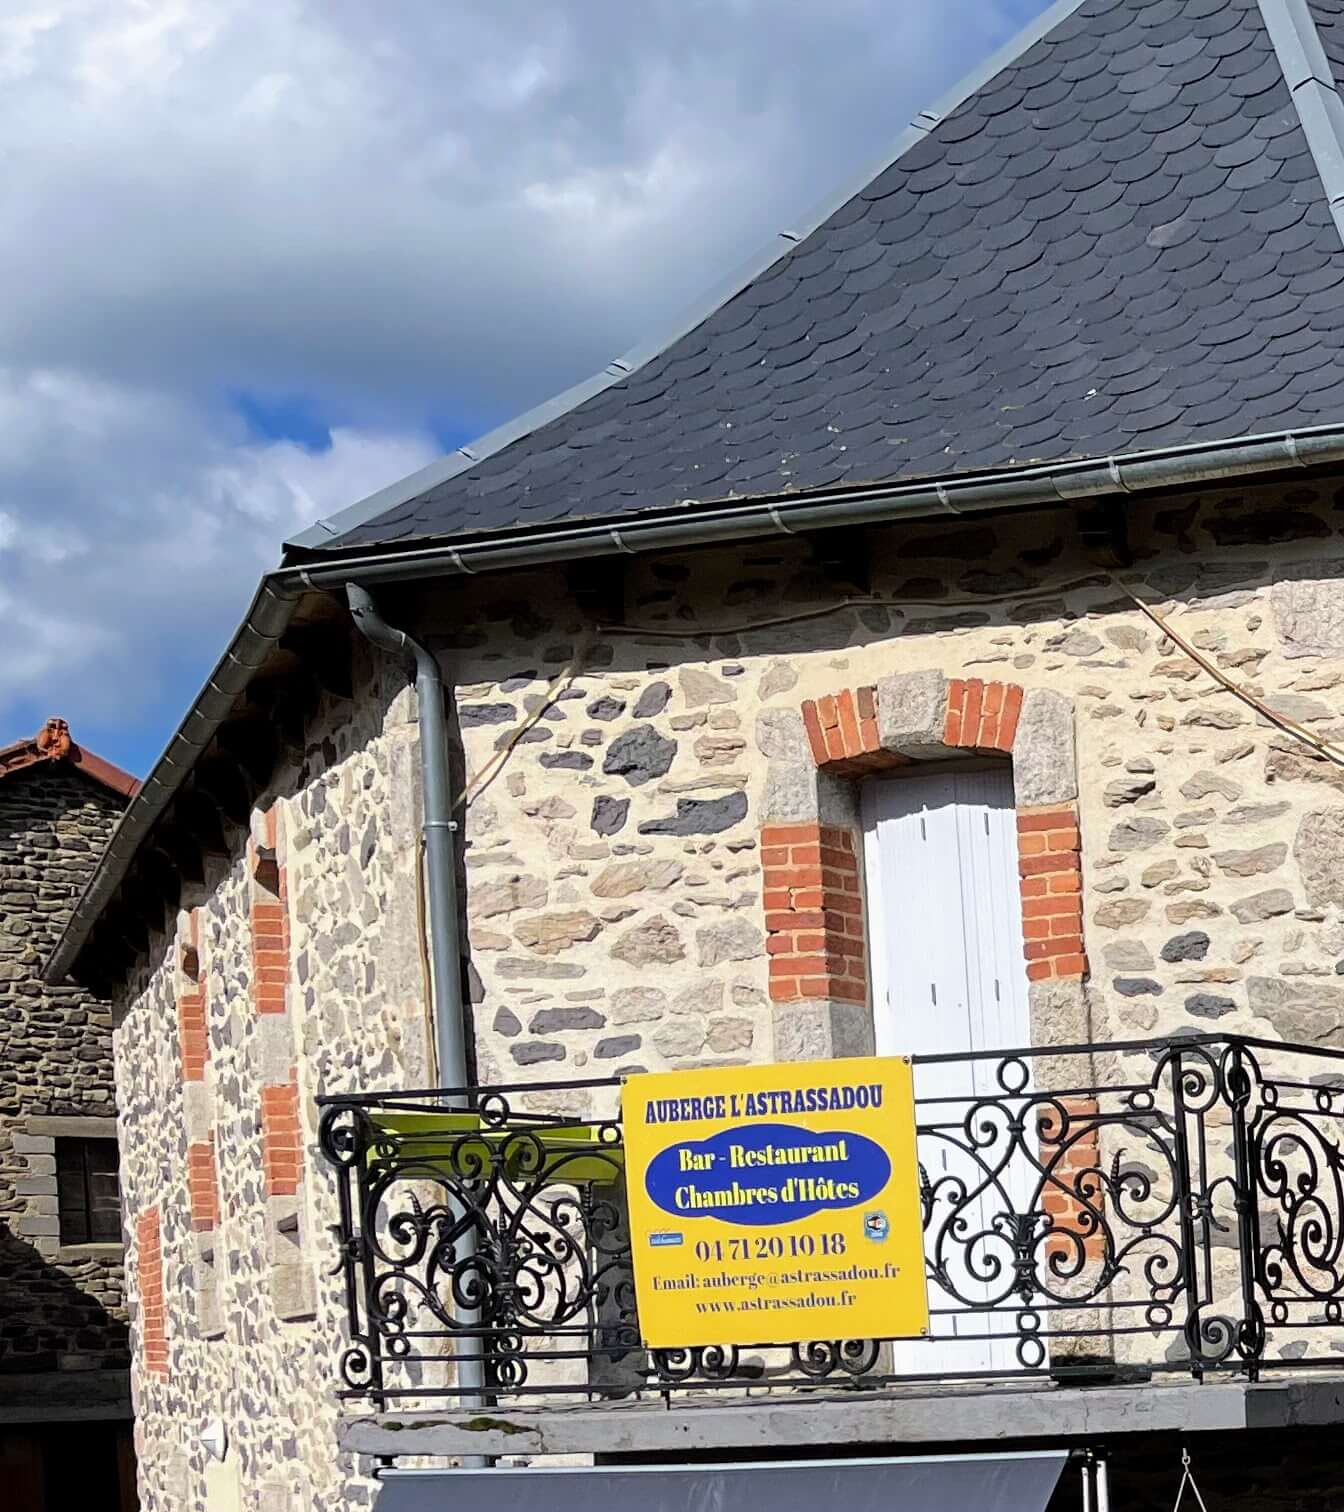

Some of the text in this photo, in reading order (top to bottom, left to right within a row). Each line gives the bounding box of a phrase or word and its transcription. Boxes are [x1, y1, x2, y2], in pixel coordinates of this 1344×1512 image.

[645, 1084, 883, 1124] AUBERGE L'ASTRASSADOU
[679, 1148, 716, 1172] Bar
[729, 1139, 849, 1168] Restaurant
[675, 1177, 860, 1209] Chambres d'Hôtes
[729, 1238, 751, 1260] 71
[755, 1236, 783, 1258] 20
[821, 1232, 846, 1255] 18
[652, 1273, 700, 1291] Email:
[696, 1291, 857, 1313] www.astrassadou.fr
